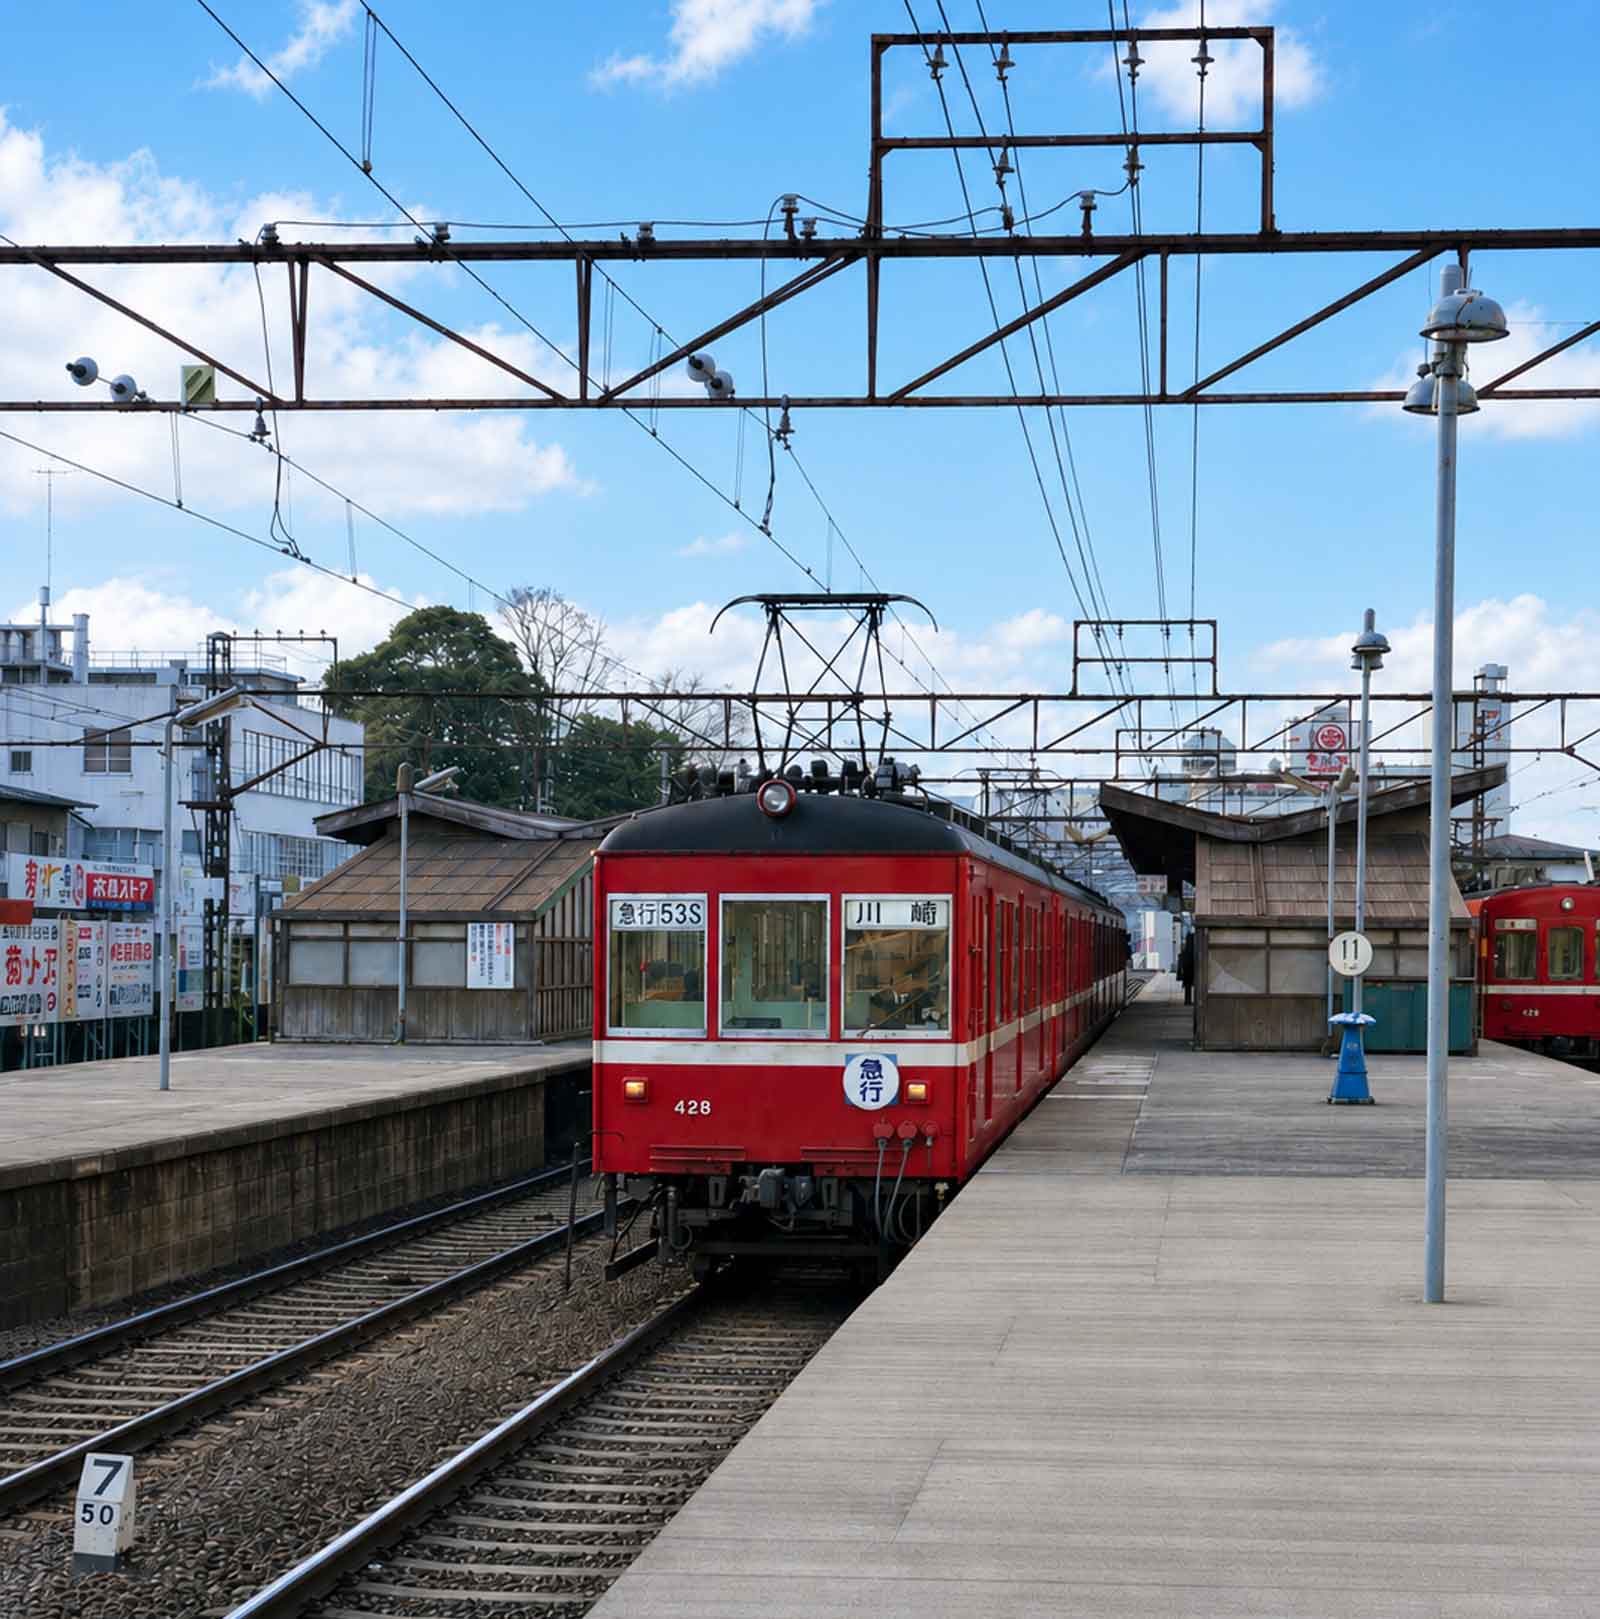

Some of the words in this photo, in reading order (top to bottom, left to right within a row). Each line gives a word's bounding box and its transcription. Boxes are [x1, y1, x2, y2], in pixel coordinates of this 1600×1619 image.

[619, 902, 656, 925] 急行
[661, 903, 701, 924] 53S
[1342, 939, 1358, 960] 11
[860, 1058, 884, 1102] 急行
[674, 1099, 711, 1115] 428
[93, 1458, 124, 1496] 7
[81, 1503, 114, 1525] 50
